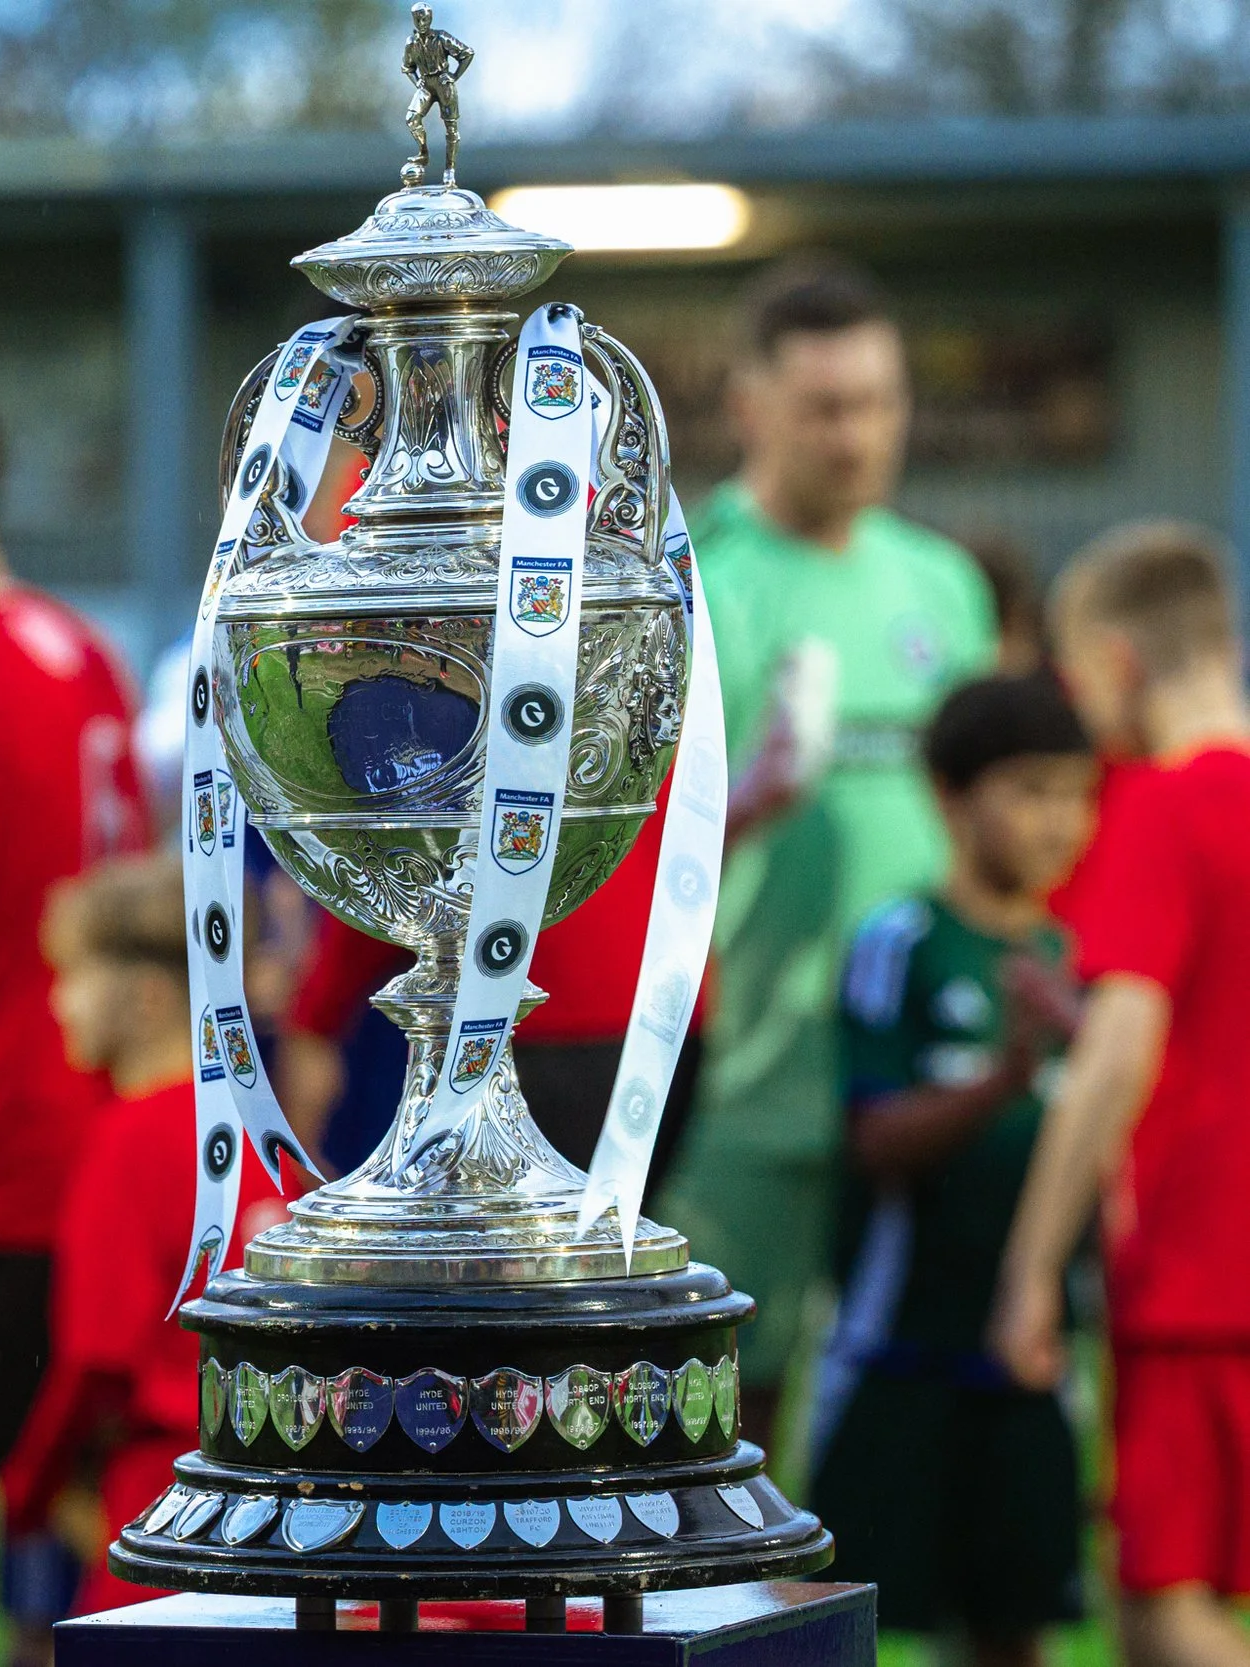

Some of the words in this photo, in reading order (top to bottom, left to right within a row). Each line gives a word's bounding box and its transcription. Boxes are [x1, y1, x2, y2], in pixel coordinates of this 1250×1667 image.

[531, 347, 569, 358] Manchester
[570, 353, 580, 363] FA
[516, 559, 557, 568] Manchester
[499, 792, 539, 803] Manchester
[539, 796, 550, 804] FA
[463, 1022, 495, 1031] Manchester
[495, 1021, 504, 1029] FA
[564, 1383, 600, 1395] LOSSOP
[628, 1381, 661, 1391] GLOSSOP
[349, 1388, 371, 1398] HYDE
[419, 1389, 444, 1399] HYDE
[495, 1389, 519, 1399] HYDE
[589, 1396, 606, 1406] END
[623, 1394, 649, 1404] NORTH
[650, 1394, 665, 1402] END
[345, 1401, 375, 1411] UNITED
[415, 1401, 448, 1411] UNITED
[490, 1401, 522, 1411] UNITE
[344, 1425, 378, 1435] 1993/94
[450, 1526, 487, 1534] ASHTON
